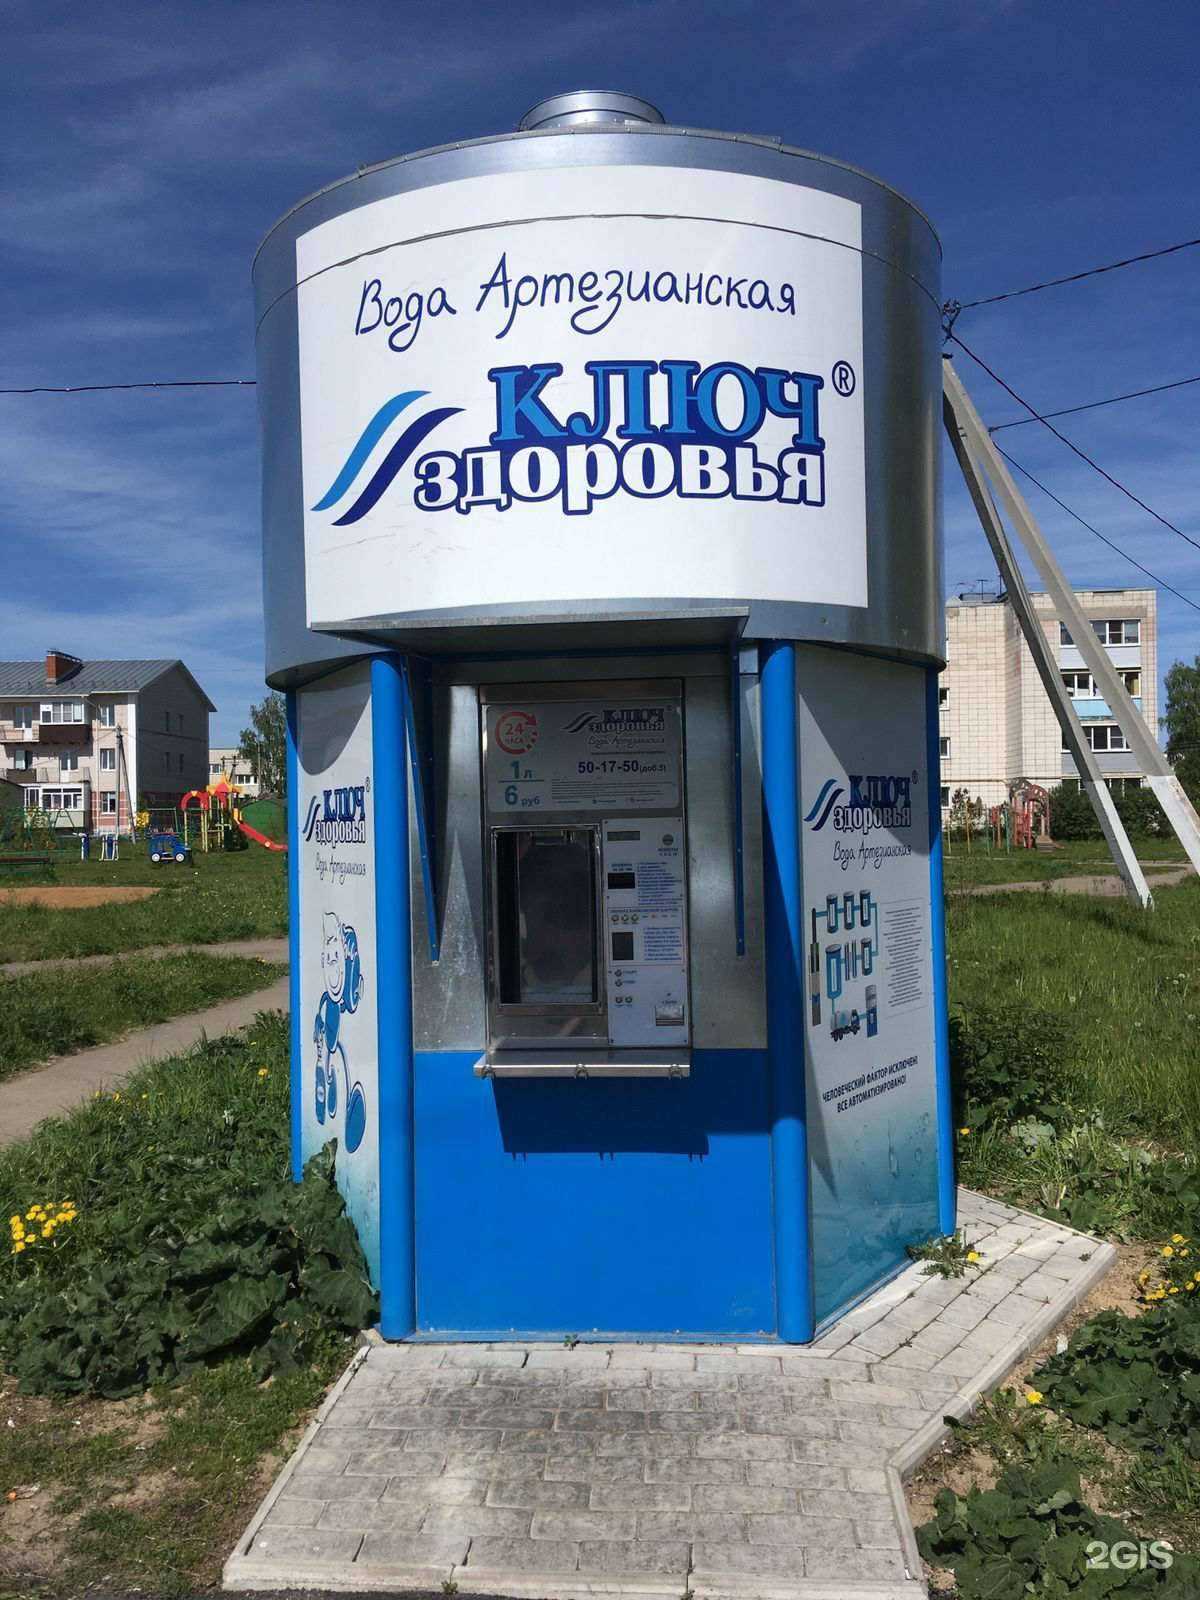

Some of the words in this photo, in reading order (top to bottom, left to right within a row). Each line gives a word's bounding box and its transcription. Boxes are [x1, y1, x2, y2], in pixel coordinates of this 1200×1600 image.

[355, 278, 456, 352] Вода
[476, 252, 796, 339] Артезианская
[488, 361, 825, 447] КЛЮЧ
[413, 440, 825, 516] здоровья
[505, 723, 525, 736] 24
[510, 761, 520, 779] 1
[323, 786, 366, 820] КЛЮЧ
[504, 785, 518, 805] 6
[521, 795, 540, 807] руб
[849, 775, 911, 808] КЛЮЧ
[833, 840, 856, 870] Вода
[823, 1074, 865, 1102] ЧЕЛОВЕЧЕСКИЙ
[867, 1066, 888, 1083] ФАКТОР
